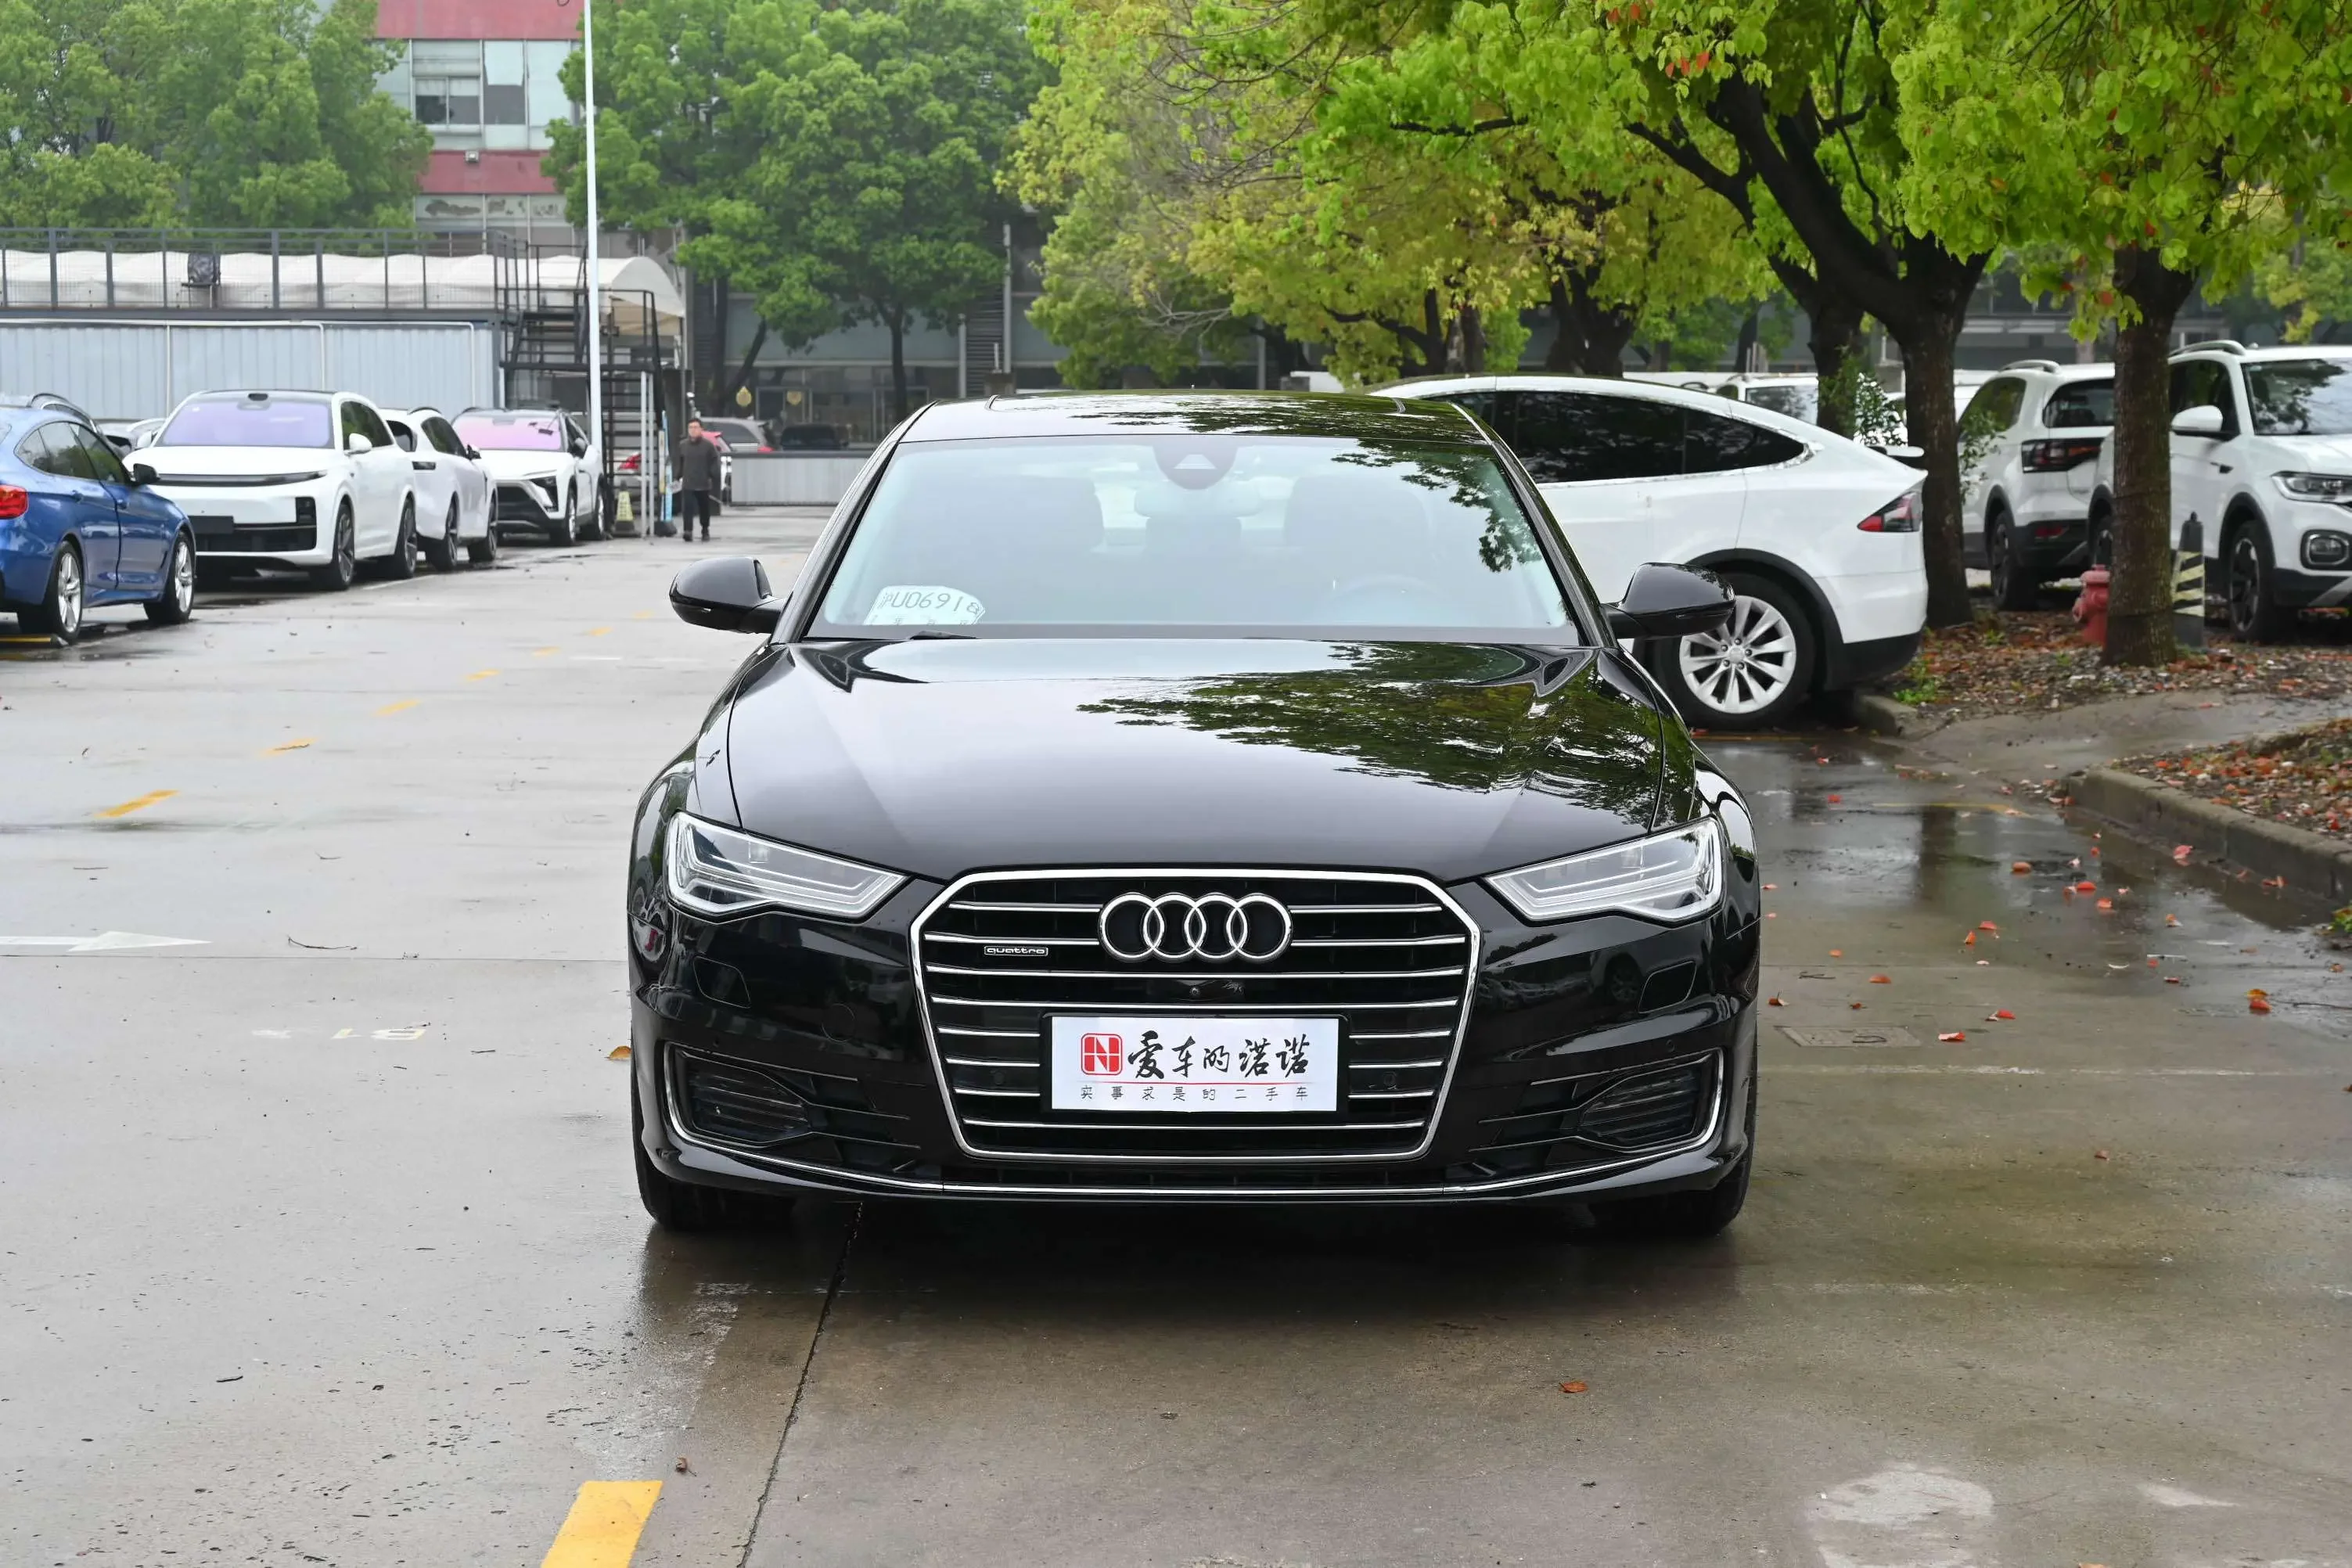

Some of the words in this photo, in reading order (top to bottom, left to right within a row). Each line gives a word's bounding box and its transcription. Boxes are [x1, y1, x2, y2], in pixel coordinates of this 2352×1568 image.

[1080, 1085, 1309, 1101] 实事求是的二手车
